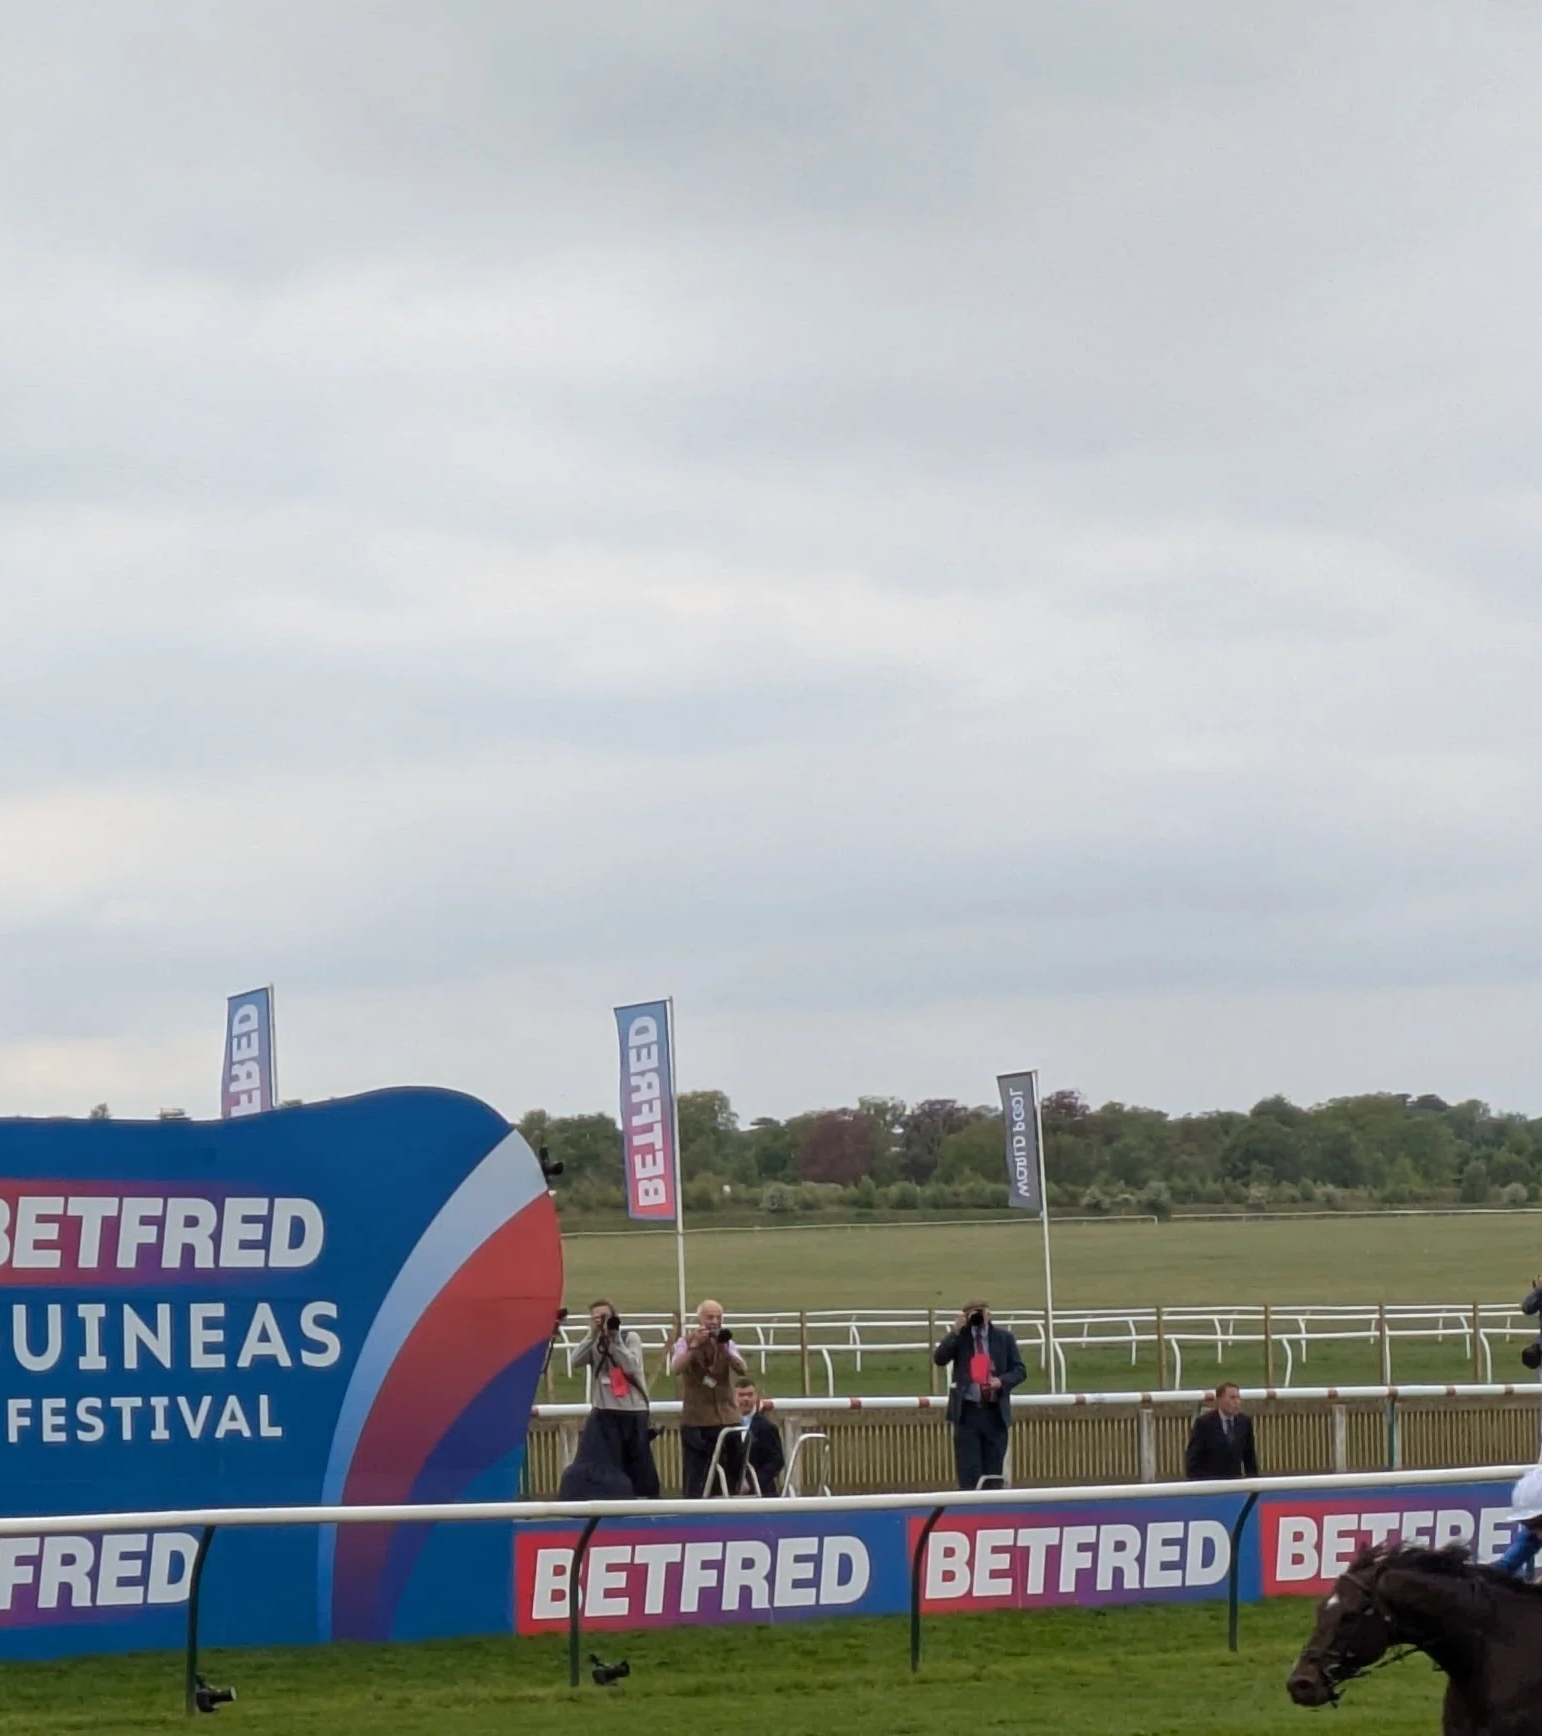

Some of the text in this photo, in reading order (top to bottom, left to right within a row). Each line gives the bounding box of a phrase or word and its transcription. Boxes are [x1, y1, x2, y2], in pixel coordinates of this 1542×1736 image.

[6, 1394, 284, 1443] FESTIVAL
[532, 1535, 871, 1620] BETFRED
[924, 1520, 1231, 1600] BETFRED
